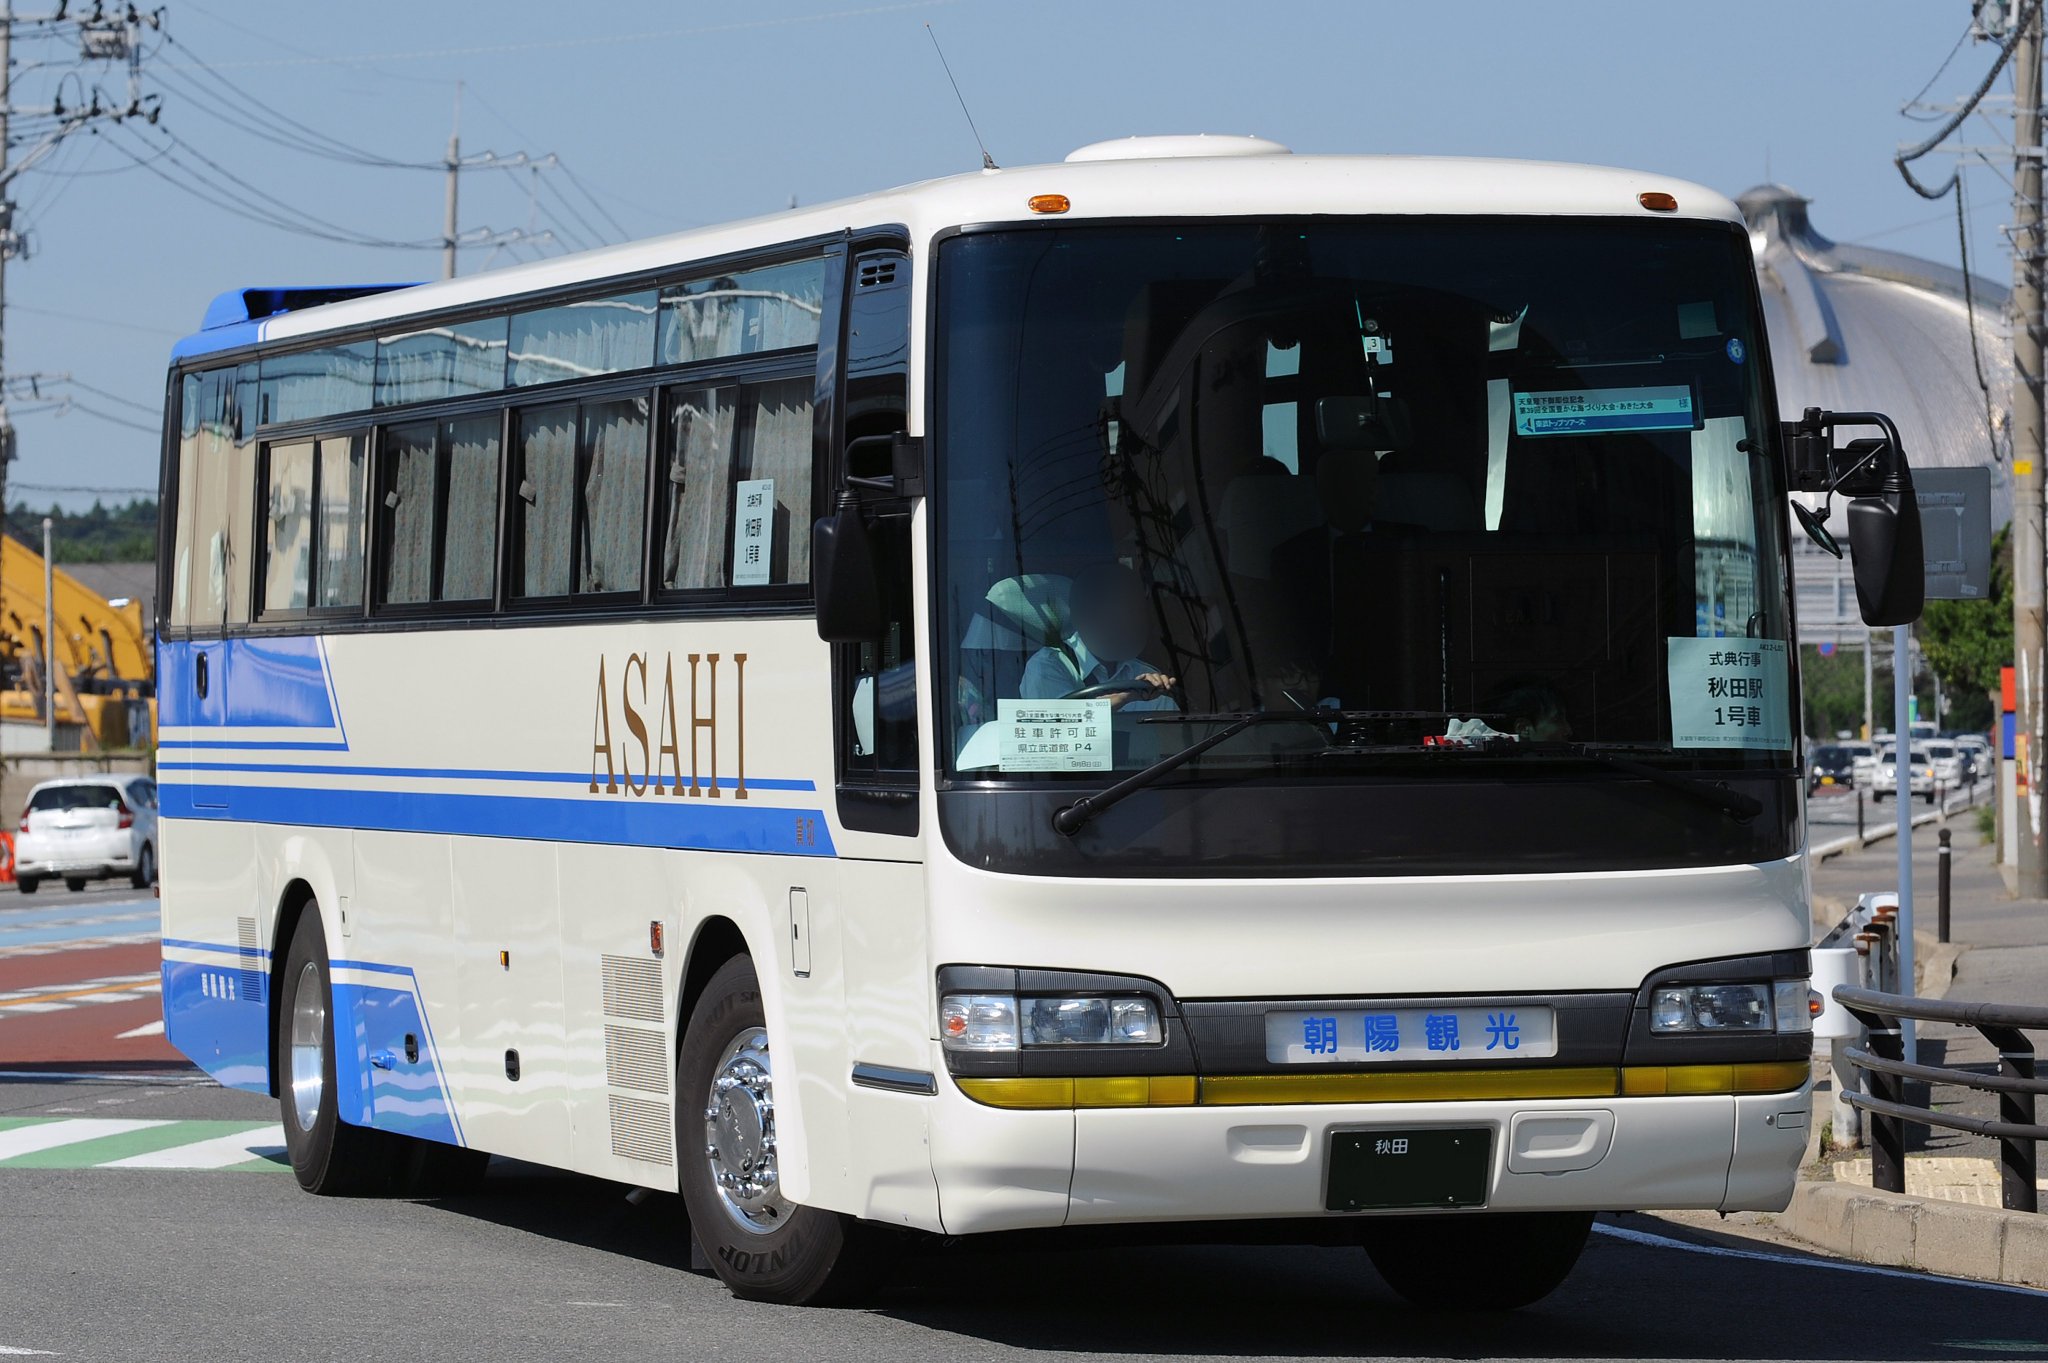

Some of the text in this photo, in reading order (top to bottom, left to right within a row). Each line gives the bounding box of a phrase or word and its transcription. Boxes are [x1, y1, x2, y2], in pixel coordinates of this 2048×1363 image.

[744, 545, 760, 565] 1号車
[1708, 651, 1762, 668] 式典行事
[1708, 677, 1764, 699] 秋田駅
[589, 651, 748, 800] ASAHI
[1714, 706, 1762, 727] 1号車
[1014, 726, 1097, 739] 駐車許可証
[1017, 743, 1069, 753] 県立武道館
[1302, 1012, 1521, 1055] 朝陽観光
[1374, 1138, 1409, 1155] 秋田
